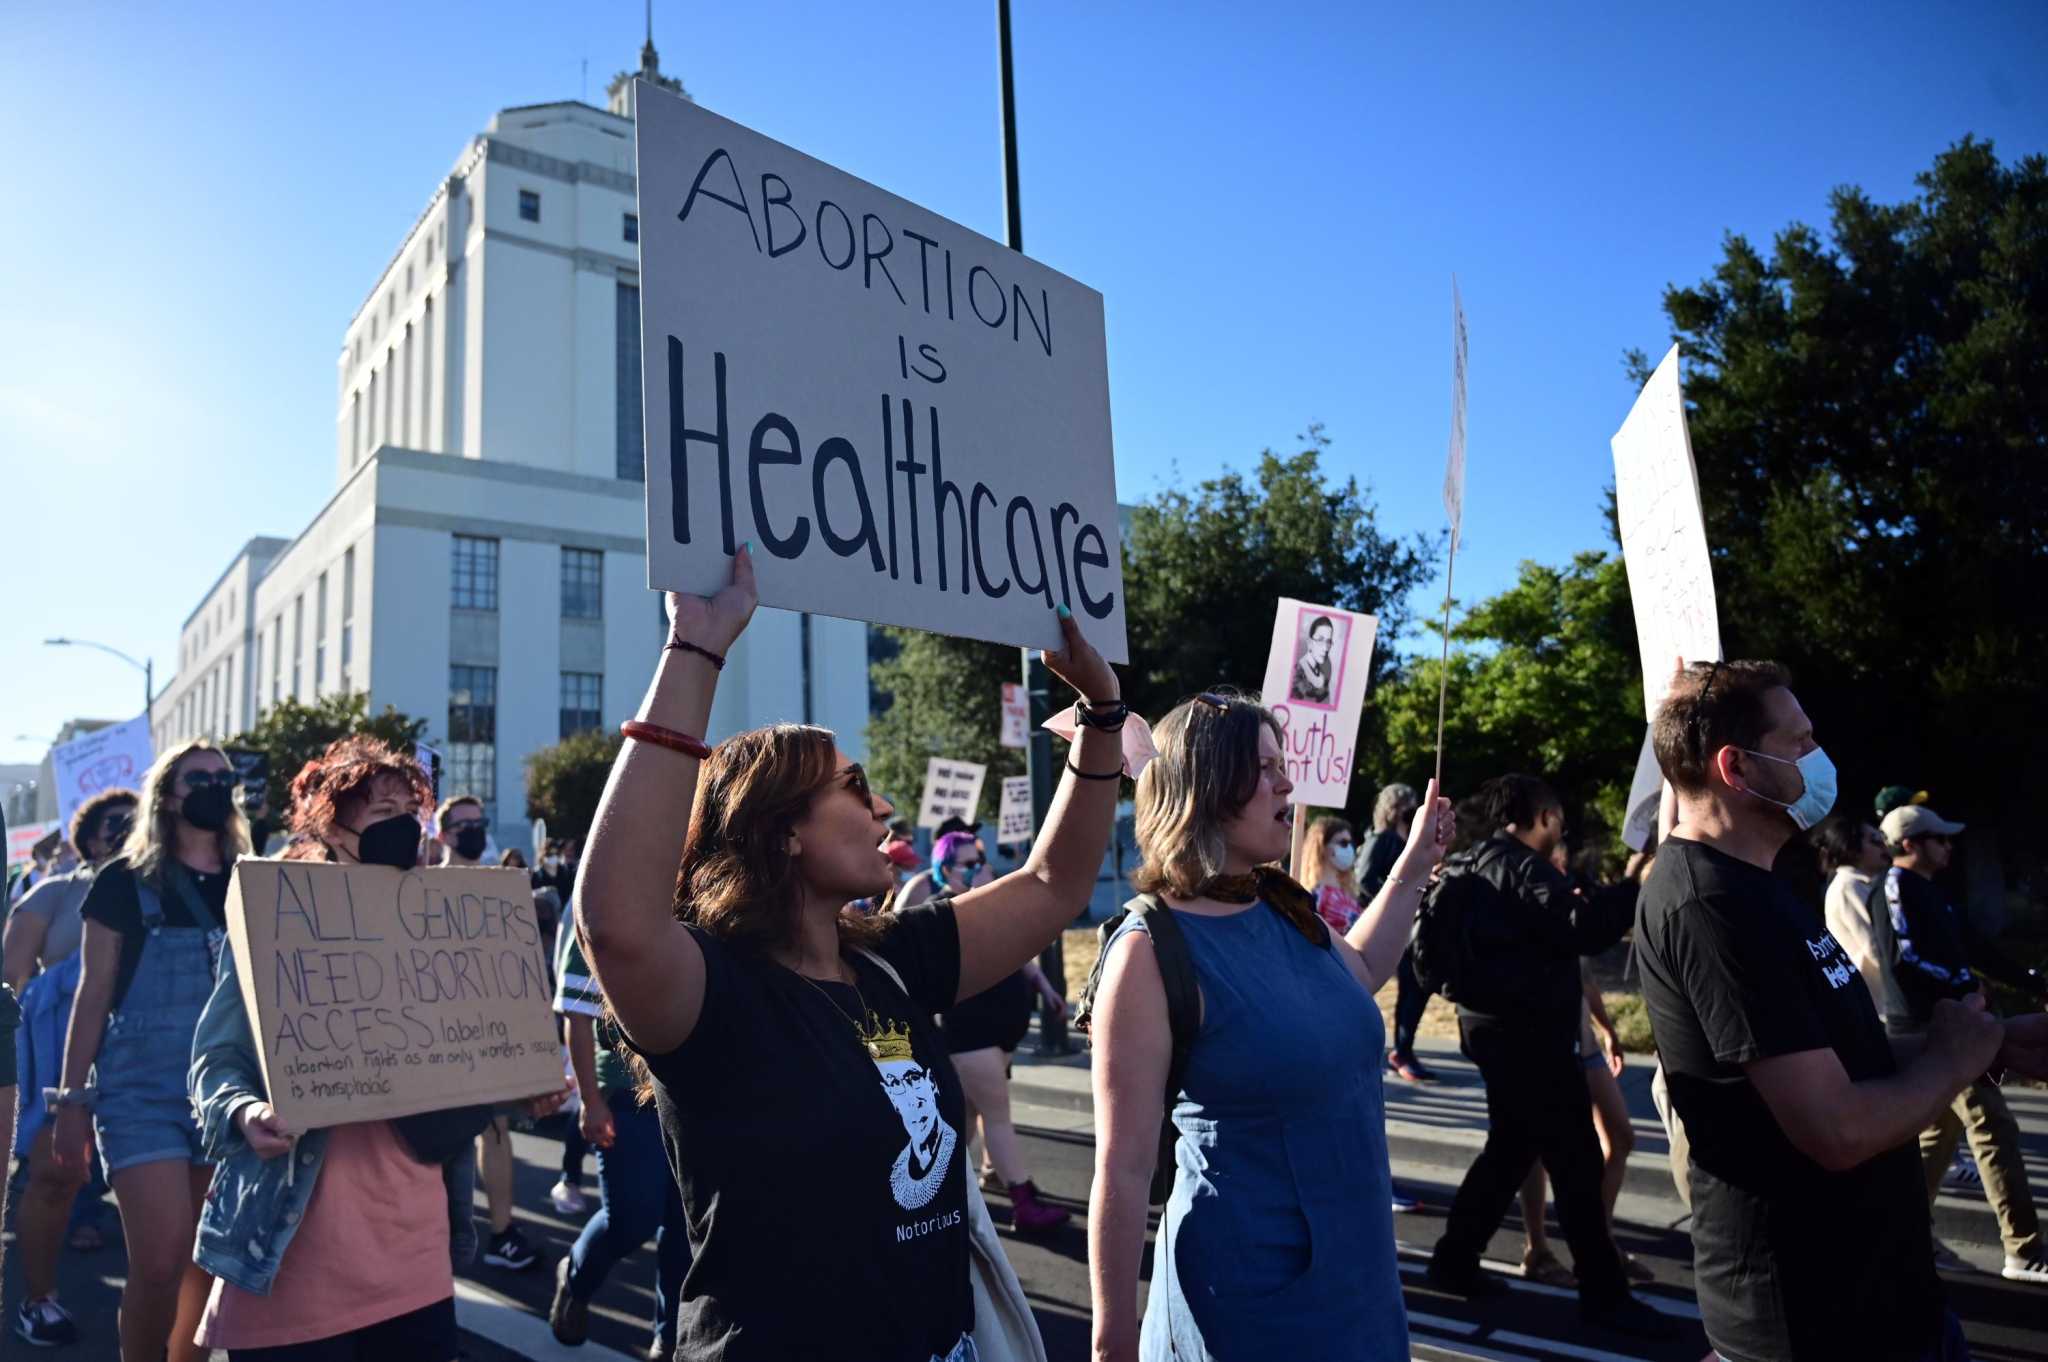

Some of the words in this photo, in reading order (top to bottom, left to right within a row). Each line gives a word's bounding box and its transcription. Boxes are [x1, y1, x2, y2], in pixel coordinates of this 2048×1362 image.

[677, 148, 1053, 357] ABORTION
[897, 335, 948, 384] IS
[667, 333, 1115, 619] Healthcare
[274, 866, 384, 942] ALL
[397, 871, 538, 947] GENDERS
[275, 948, 385, 1008] NEED
[394, 947, 548, 1004] ABORTION
